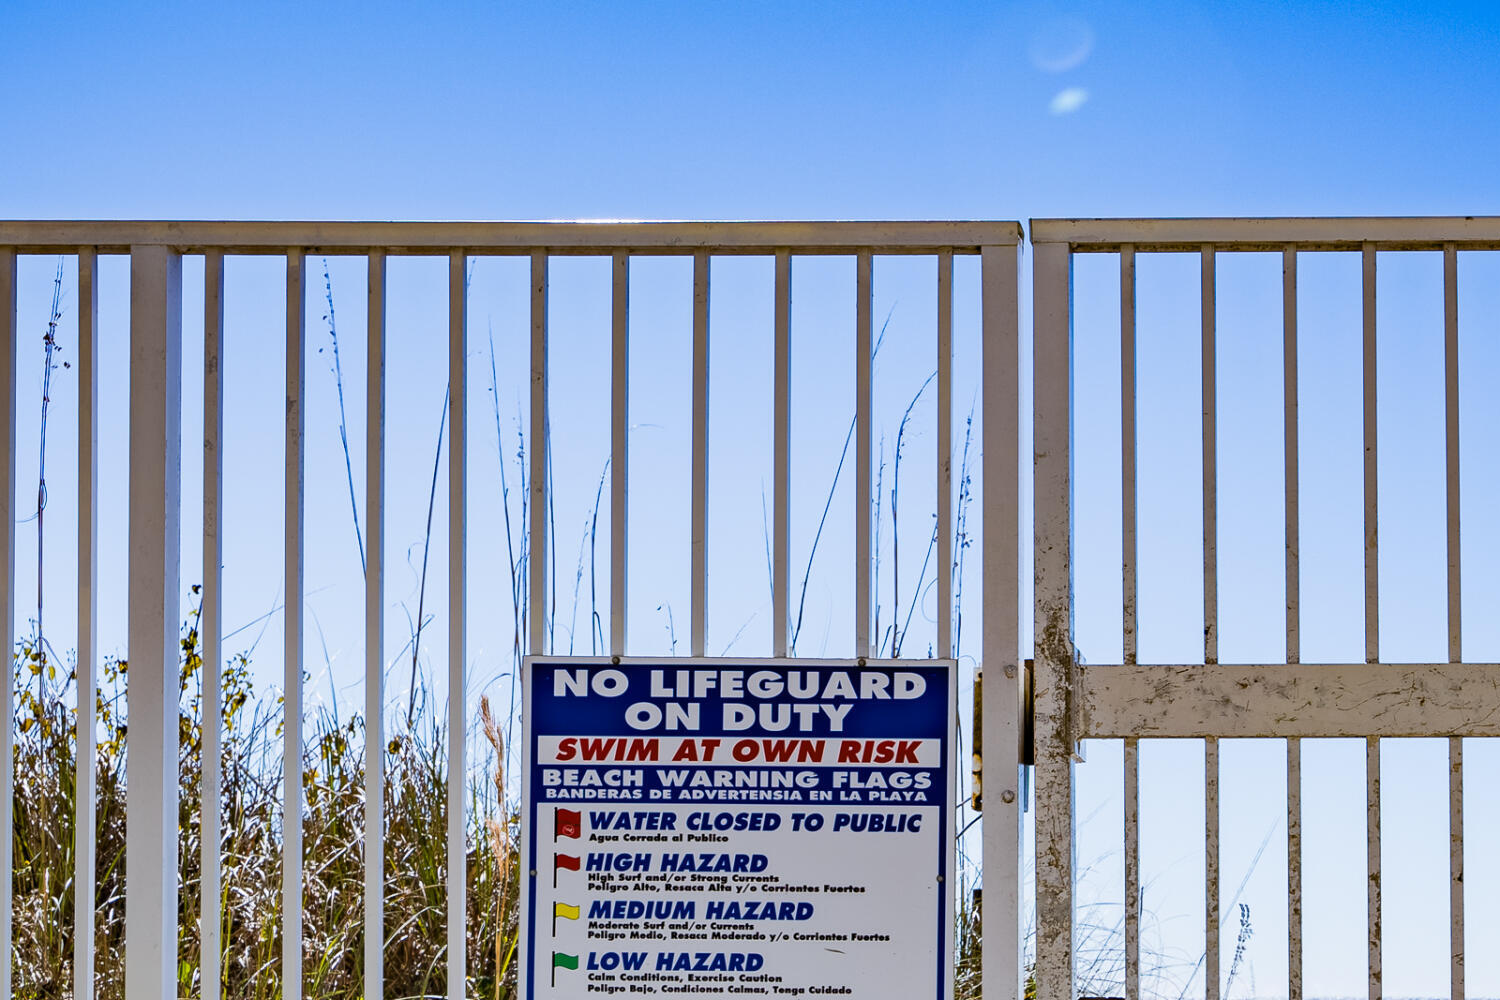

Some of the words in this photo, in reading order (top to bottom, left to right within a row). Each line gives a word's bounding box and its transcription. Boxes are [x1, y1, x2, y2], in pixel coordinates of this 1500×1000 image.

[553, 669, 629, 698] NO
[650, 670, 927, 699] LIFEGUARD
[624, 702, 700, 731] ON
[722, 703, 854, 732] DUTY
[555, 738, 659, 761] SWIM
[672, 739, 721, 762] AT
[732, 739, 826, 763] OWN
[837, 740, 923, 763] RISK
[543, 769, 644, 786] BEACH
[656, 769, 820, 788] WARNING
[832, 771, 931, 789] FLAGS
[546, 788, 642, 799] BANDERAS
[650, 789, 672, 800] DE
[678, 789, 802, 801] ADVERTENSIA
[809, 791, 833, 800] EN
[840, 791, 861, 801] LA
[869, 791, 927, 801] PLAYA
[589, 811, 677, 831] WATER
[686, 812, 781, 831] CLOSED
[791, 813, 824, 832] TO
[833, 813, 922, 833] PUBLIC
[589, 833, 619, 843] Agua
[623, 834, 668, 843] Cerrada
[672, 833, 683, 842] al
[687, 834, 729, 843] Publico
[586, 853, 652, 872] HIGH
[660, 853, 768, 872] HAZARD
[588, 873, 614, 883] High
[618, 873, 642, 882] Surf
[645, 873, 686, 883] and/or
[690, 873, 727, 884] Strong
[732, 874, 779, 883] Currents
[588, 882, 629, 892] Peligro
[632, 883, 660, 892] Alto,
[665, 883, 704, 892] Resaca
[708, 883, 732, 892] Alta
[736, 883, 757, 894] y/o
[761, 884, 820, 893] Corrientes
[823, 884, 865, 893] Fuertes
[588, 900, 696, 919] MEDIUM
[705, 901, 814, 920] HAZARD
[588, 921, 640, 930] Moderate
[643, 921, 665, 930] Surf
[668, 921, 707, 931] and/or
[710, 922, 754, 931] Currents
[587, 931, 626, 941] Peligro
[630, 931, 667, 941] Medio,
[671, 932, 707, 940] Resaca
[711, 932, 766, 941] Moderado
[769, 932, 790, 942] y/o
[793, 932, 848, 941] Corrientes
[851, 933, 890, 942] Fuertes
[586, 952, 648, 971] LOW
[656, 952, 763, 971] HAZARD
[588, 973, 615, 982] Calm
[620, 973, 683, 983] Conditions,
[688, 973, 735, 982] Exercise
[739, 974, 782, 983] Caution
[587, 985, 626, 994] Peligro
[630, 985, 657, 994] Bajo,
[661, 985, 724, 994] Condiciones
[727, 985, 769, 995] Calmas,
[772, 986, 805, 996] Tenga
[808, 986, 852, 994] Cuidado
